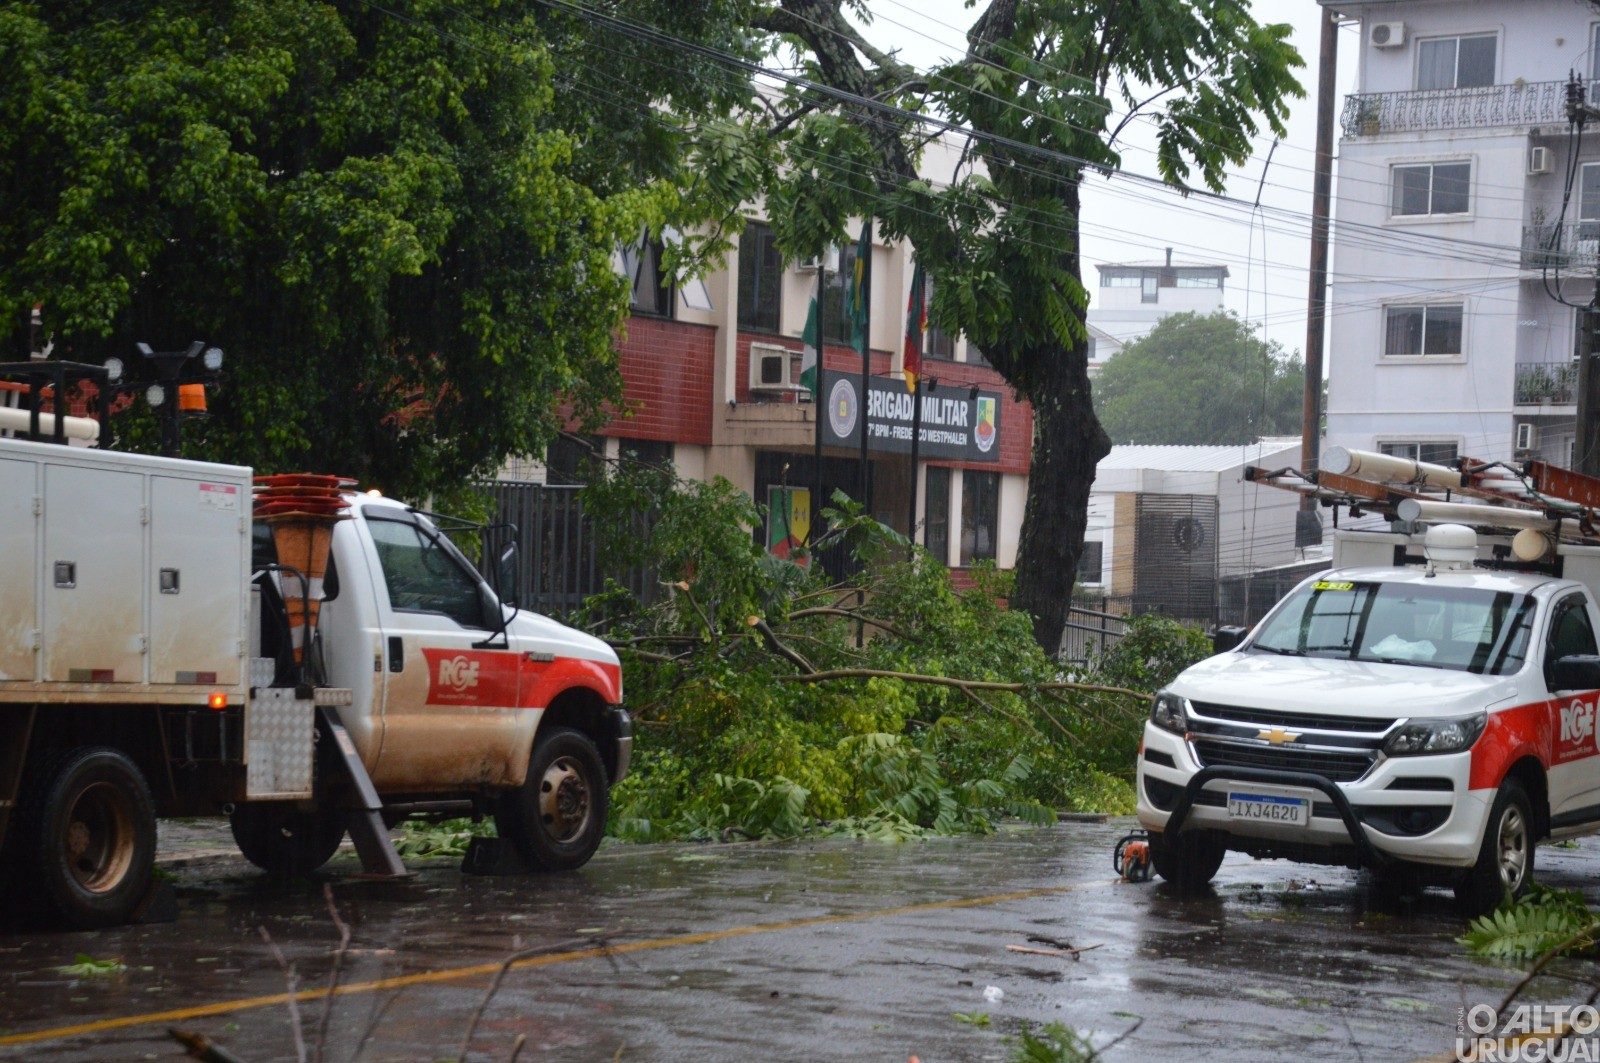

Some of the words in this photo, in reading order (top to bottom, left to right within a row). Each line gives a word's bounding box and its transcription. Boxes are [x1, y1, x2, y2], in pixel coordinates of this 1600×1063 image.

[921, 396, 968, 427] MILITAR
[875, 424, 890, 438] BPM
[893, 426, 927, 441] FREDECO
[928, 430, 968, 446] WESTPHALEN
[438, 655, 480, 692] RGE
[1560, 699, 1594, 745] RGE
